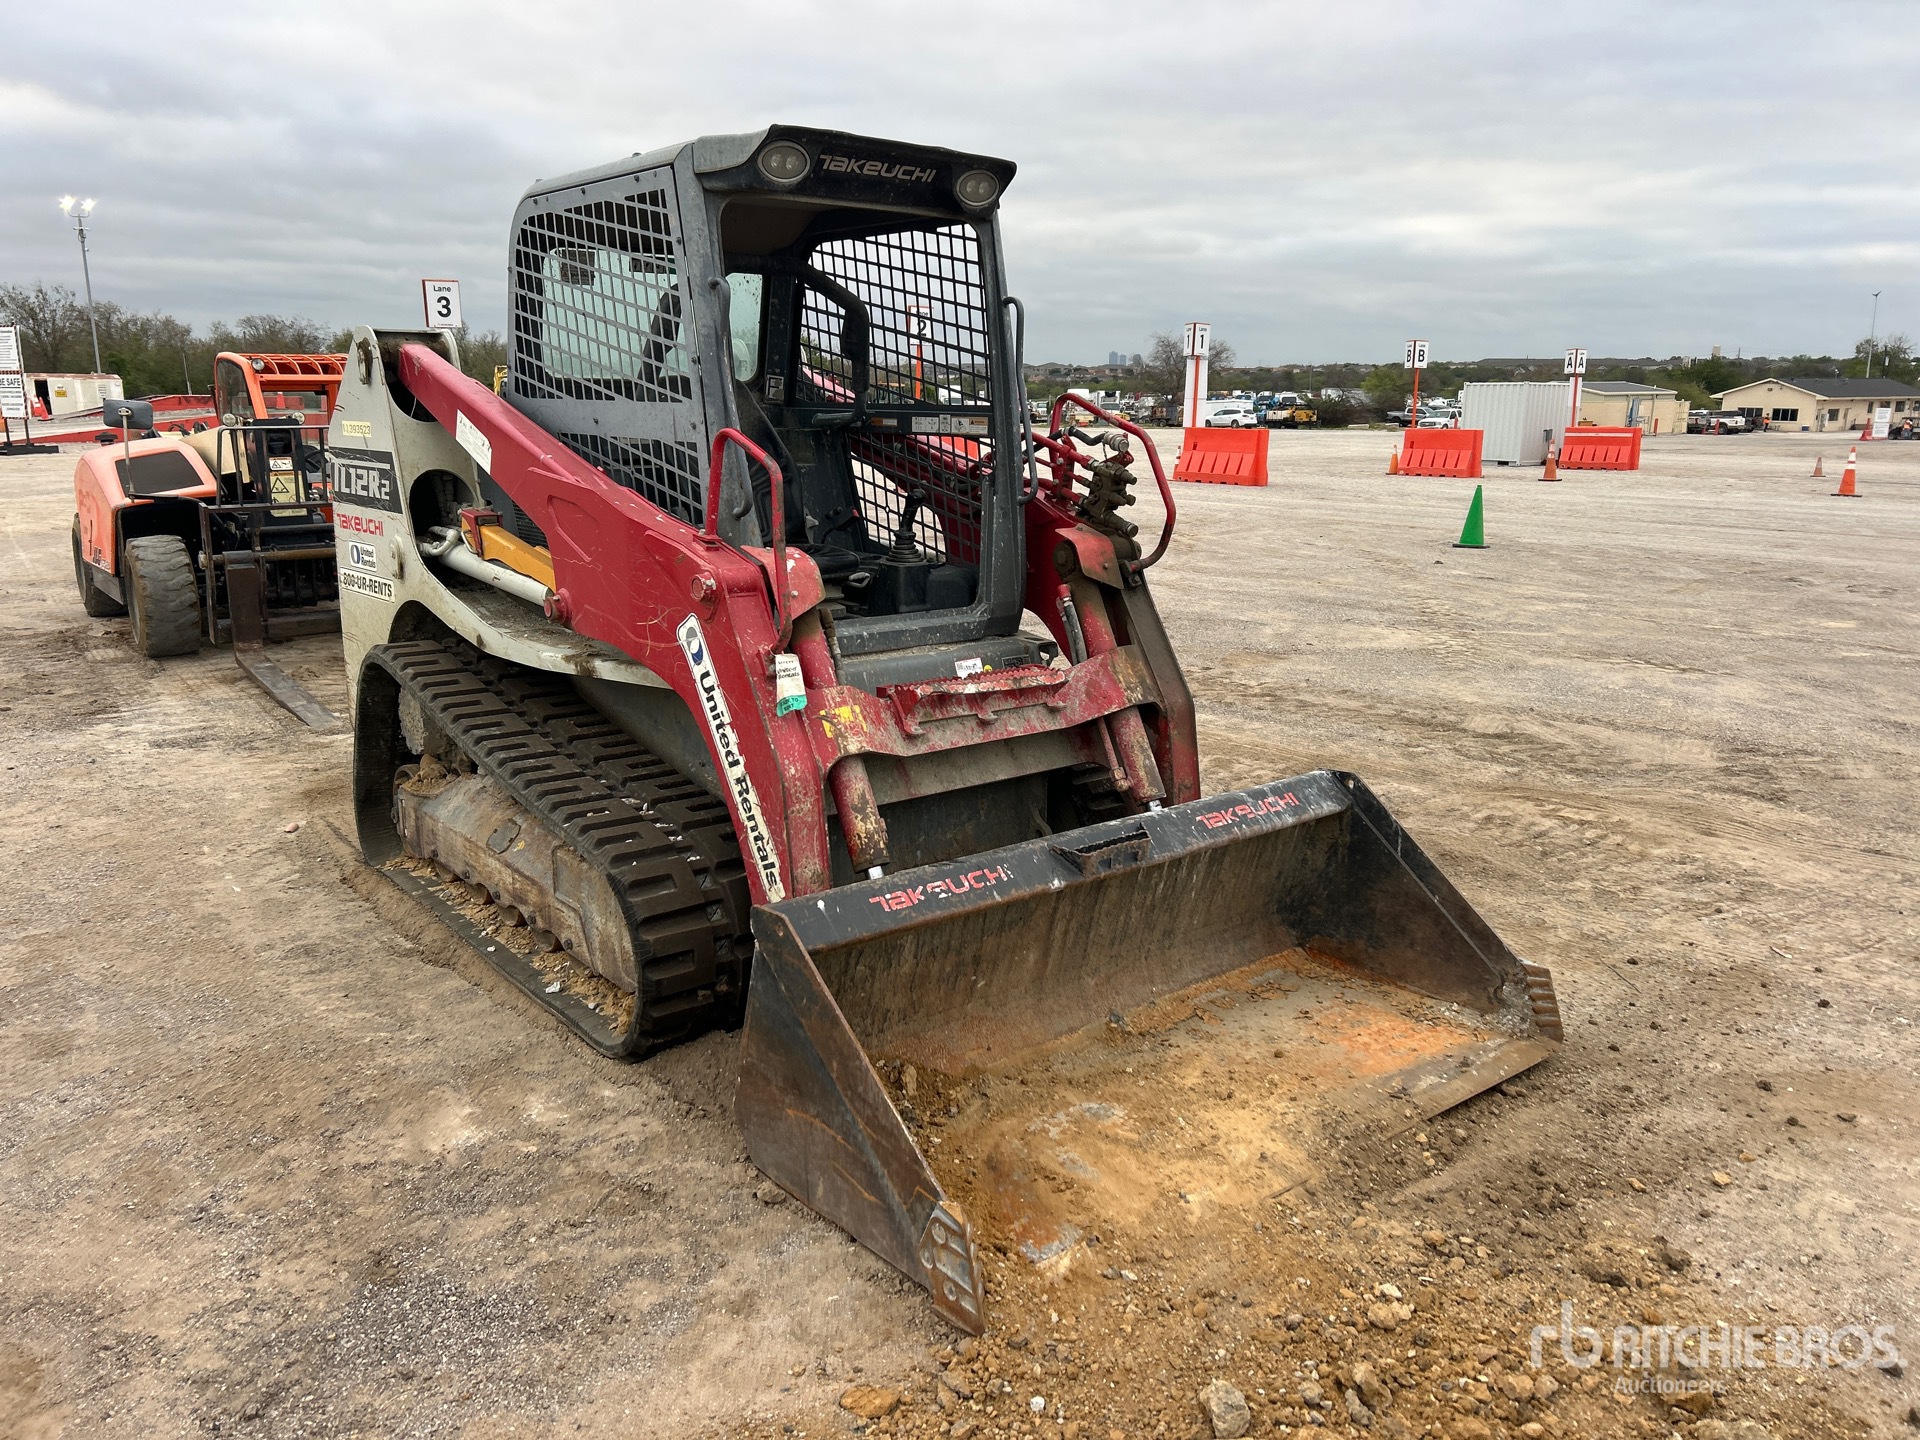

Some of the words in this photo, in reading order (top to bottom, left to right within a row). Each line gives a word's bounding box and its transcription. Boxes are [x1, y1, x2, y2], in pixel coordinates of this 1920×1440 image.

[436, 296, 452, 318] 3
[917, 320, 927, 337] 2
[1187, 334, 1190, 349] 1
[1200, 334, 1204, 349] 1
[1407, 349, 1411, 362] B
[1418, 349, 1425, 362] B
[1566, 356, 1572, 368] A
[1578, 356, 1583, 368] A
[6, 377, 21, 386] SAFE
[361, 547, 373, 558] United
[360, 557, 376, 569] Rentals
[700, 669, 741, 769] United
[733, 774, 779, 892] Rentals
